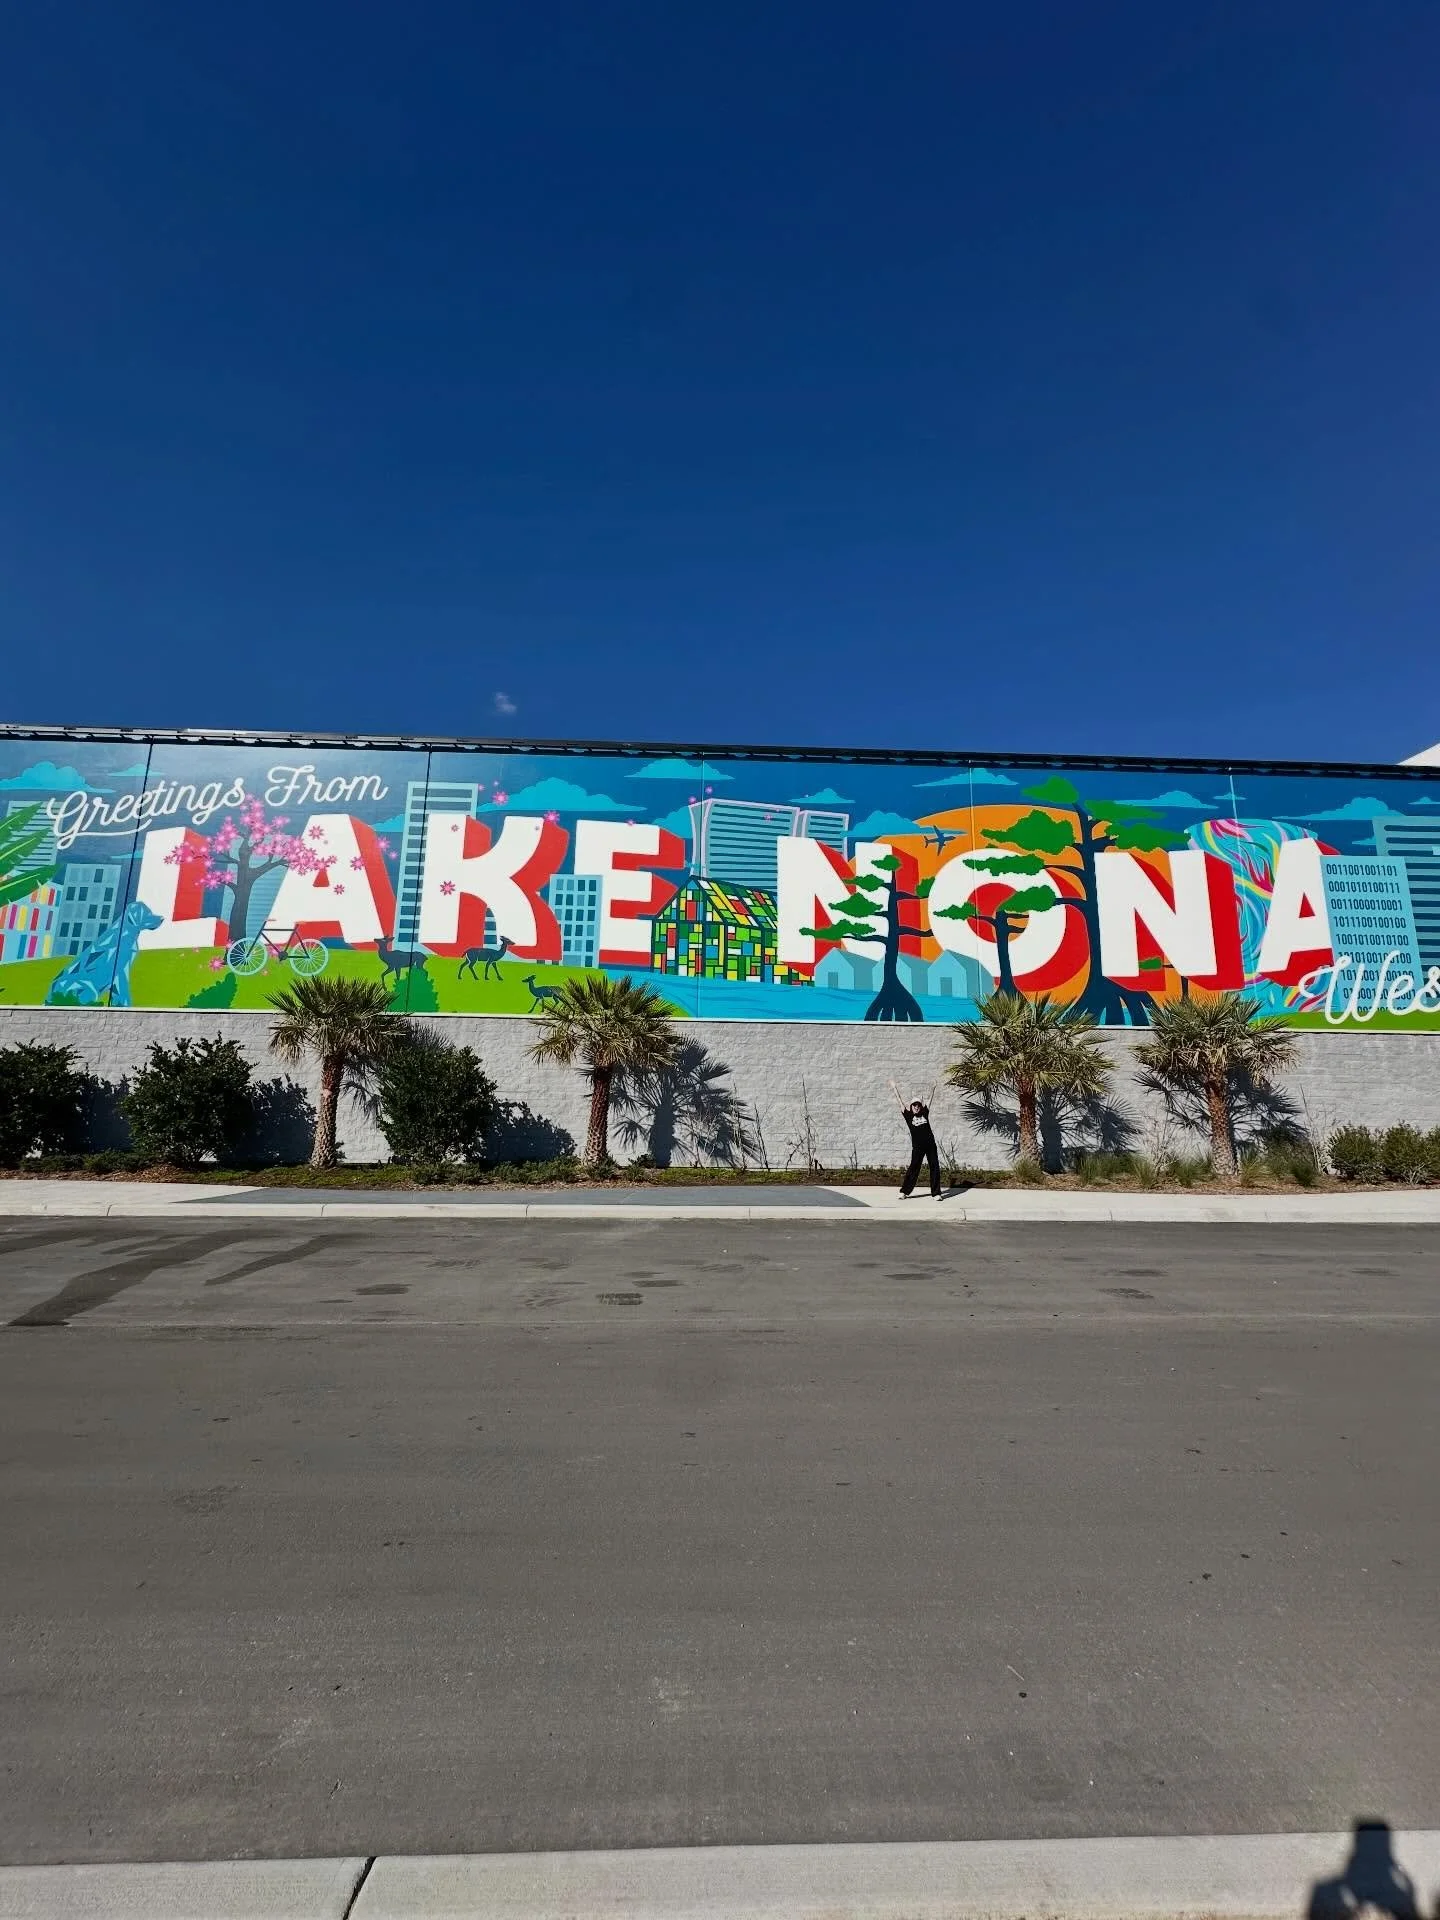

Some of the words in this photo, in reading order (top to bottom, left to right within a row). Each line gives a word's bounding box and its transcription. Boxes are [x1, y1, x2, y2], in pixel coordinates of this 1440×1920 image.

[46, 776, 246, 850] Greetings
[264, 764, 389, 807] From
[136, 813, 661, 951] LAKE
[776, 835, 1337, 979] NONA
